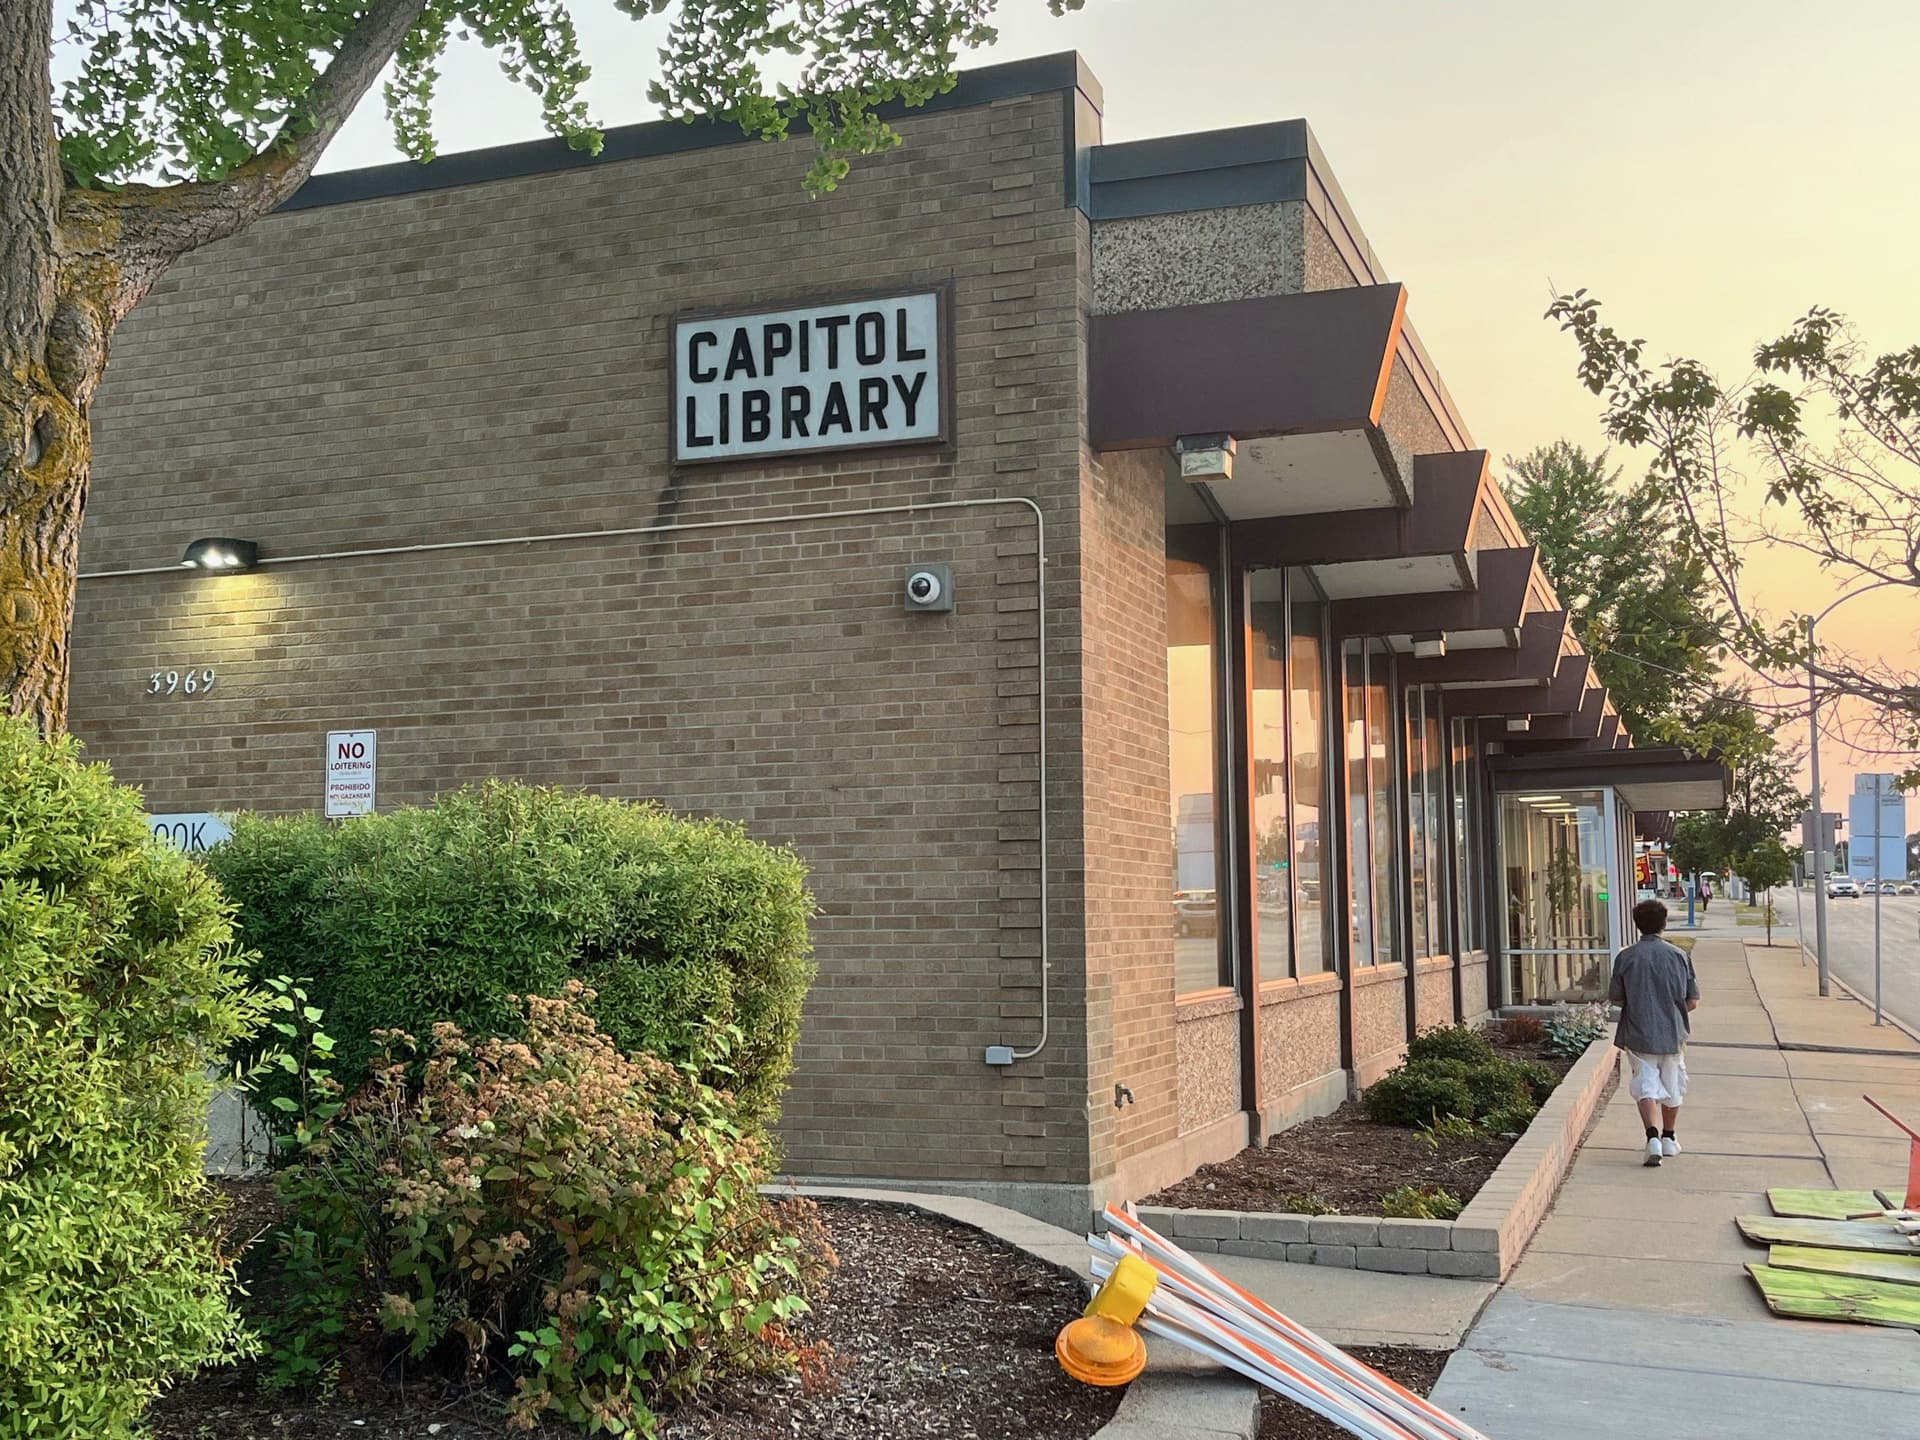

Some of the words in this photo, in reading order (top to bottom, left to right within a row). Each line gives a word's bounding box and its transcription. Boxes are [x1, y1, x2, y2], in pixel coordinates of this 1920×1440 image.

[689, 308, 926, 383] CAPITOL
[686, 371, 927, 448] LIBRARY
[146, 669, 216, 695] 3969
[338, 742, 365, 760] NO
[330, 761, 372, 771] LOITERING
[330, 783, 371, 791] PROHIBIDO
